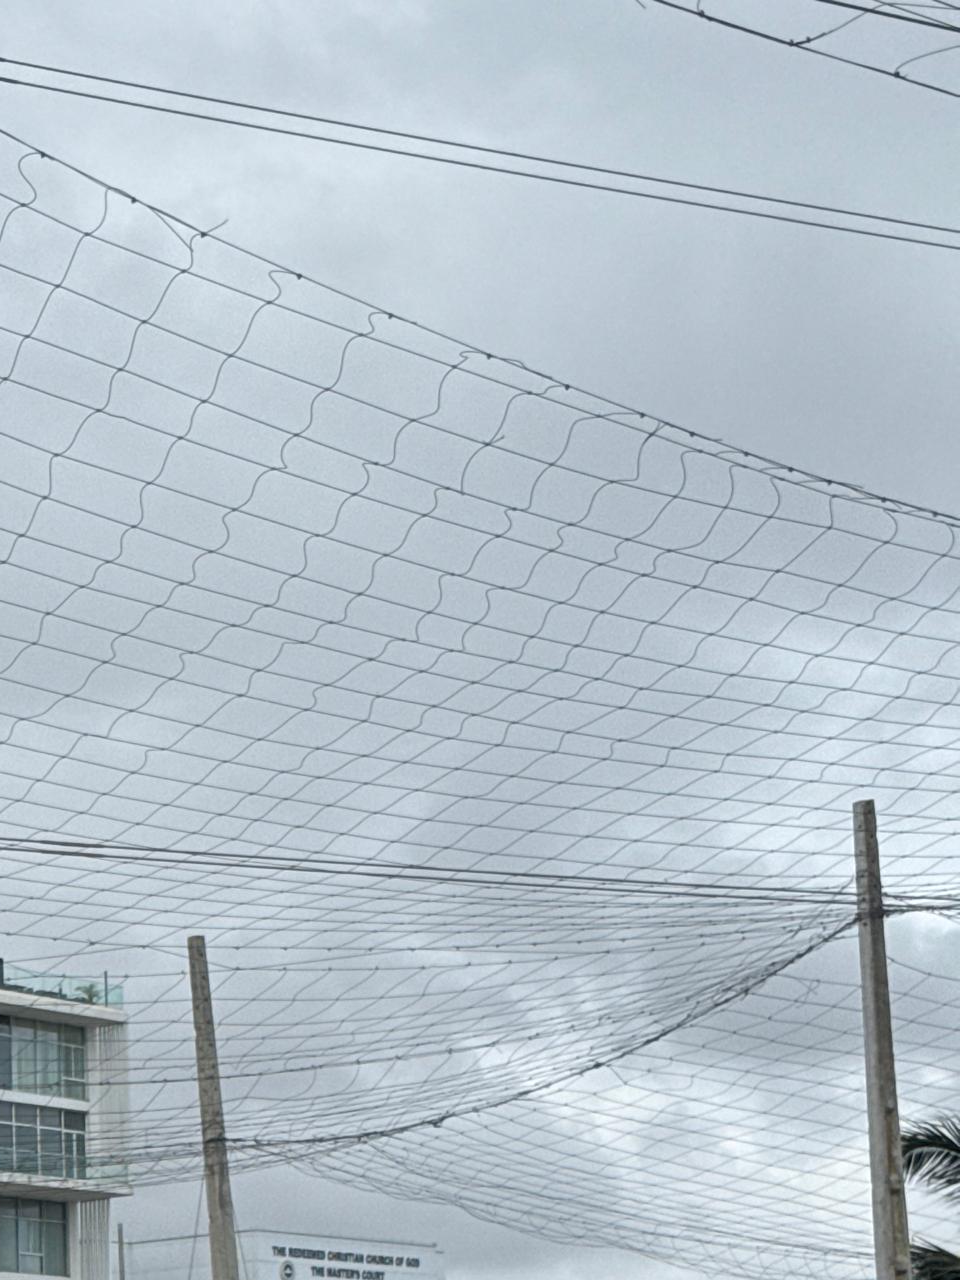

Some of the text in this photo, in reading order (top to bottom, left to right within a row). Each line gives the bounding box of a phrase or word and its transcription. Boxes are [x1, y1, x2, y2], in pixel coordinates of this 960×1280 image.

[272, 1246, 420, 1268] THE REDEEMED CHRISTIAN CHURCH OF GOD
[311, 1266, 385, 1280] THE MASTER'S COURT
